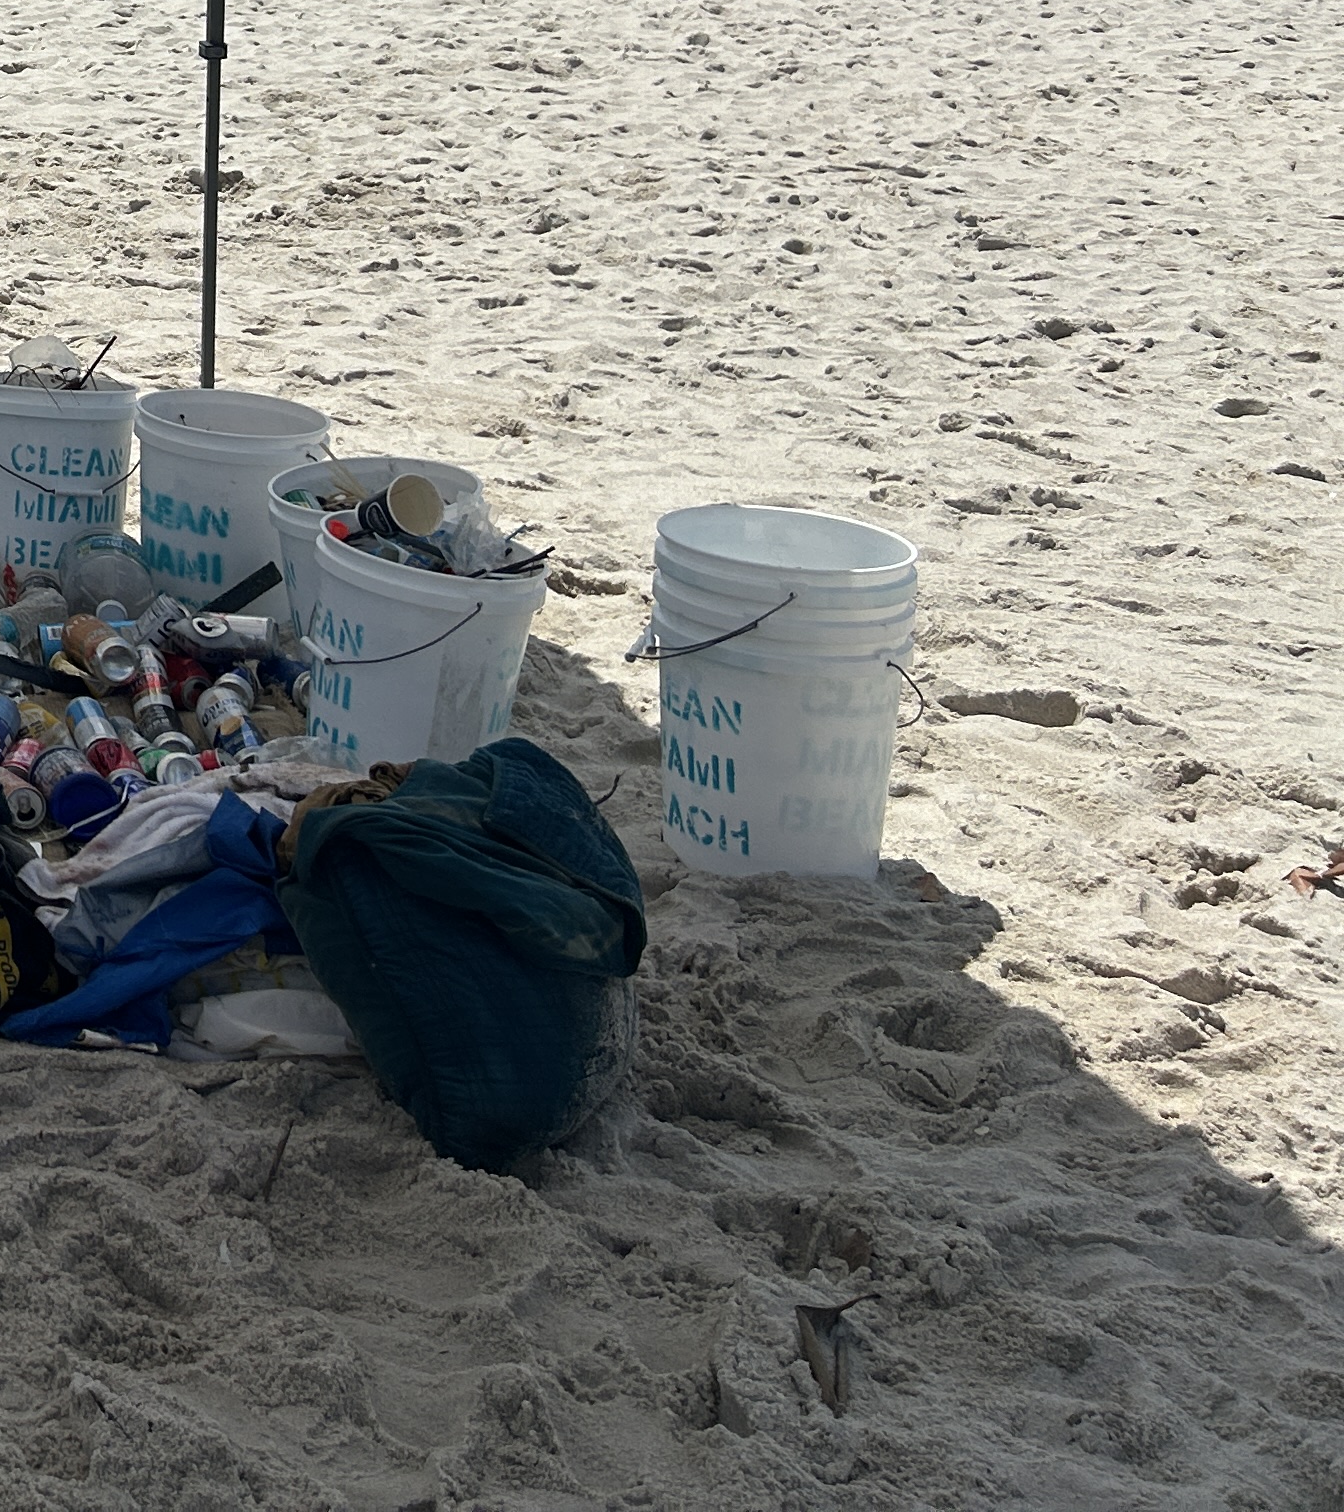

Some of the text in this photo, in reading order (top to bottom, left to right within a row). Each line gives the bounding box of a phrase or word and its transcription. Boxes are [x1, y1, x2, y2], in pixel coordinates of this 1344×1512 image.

[11, 443, 124, 478] CLEAN
[14, 489, 117, 525] MIAMI
[142, 487, 230, 539] LEAN
[6, 534, 67, 568] BEA
[663, 730, 736, 794] AMI
[663, 791, 750, 856] ACH
